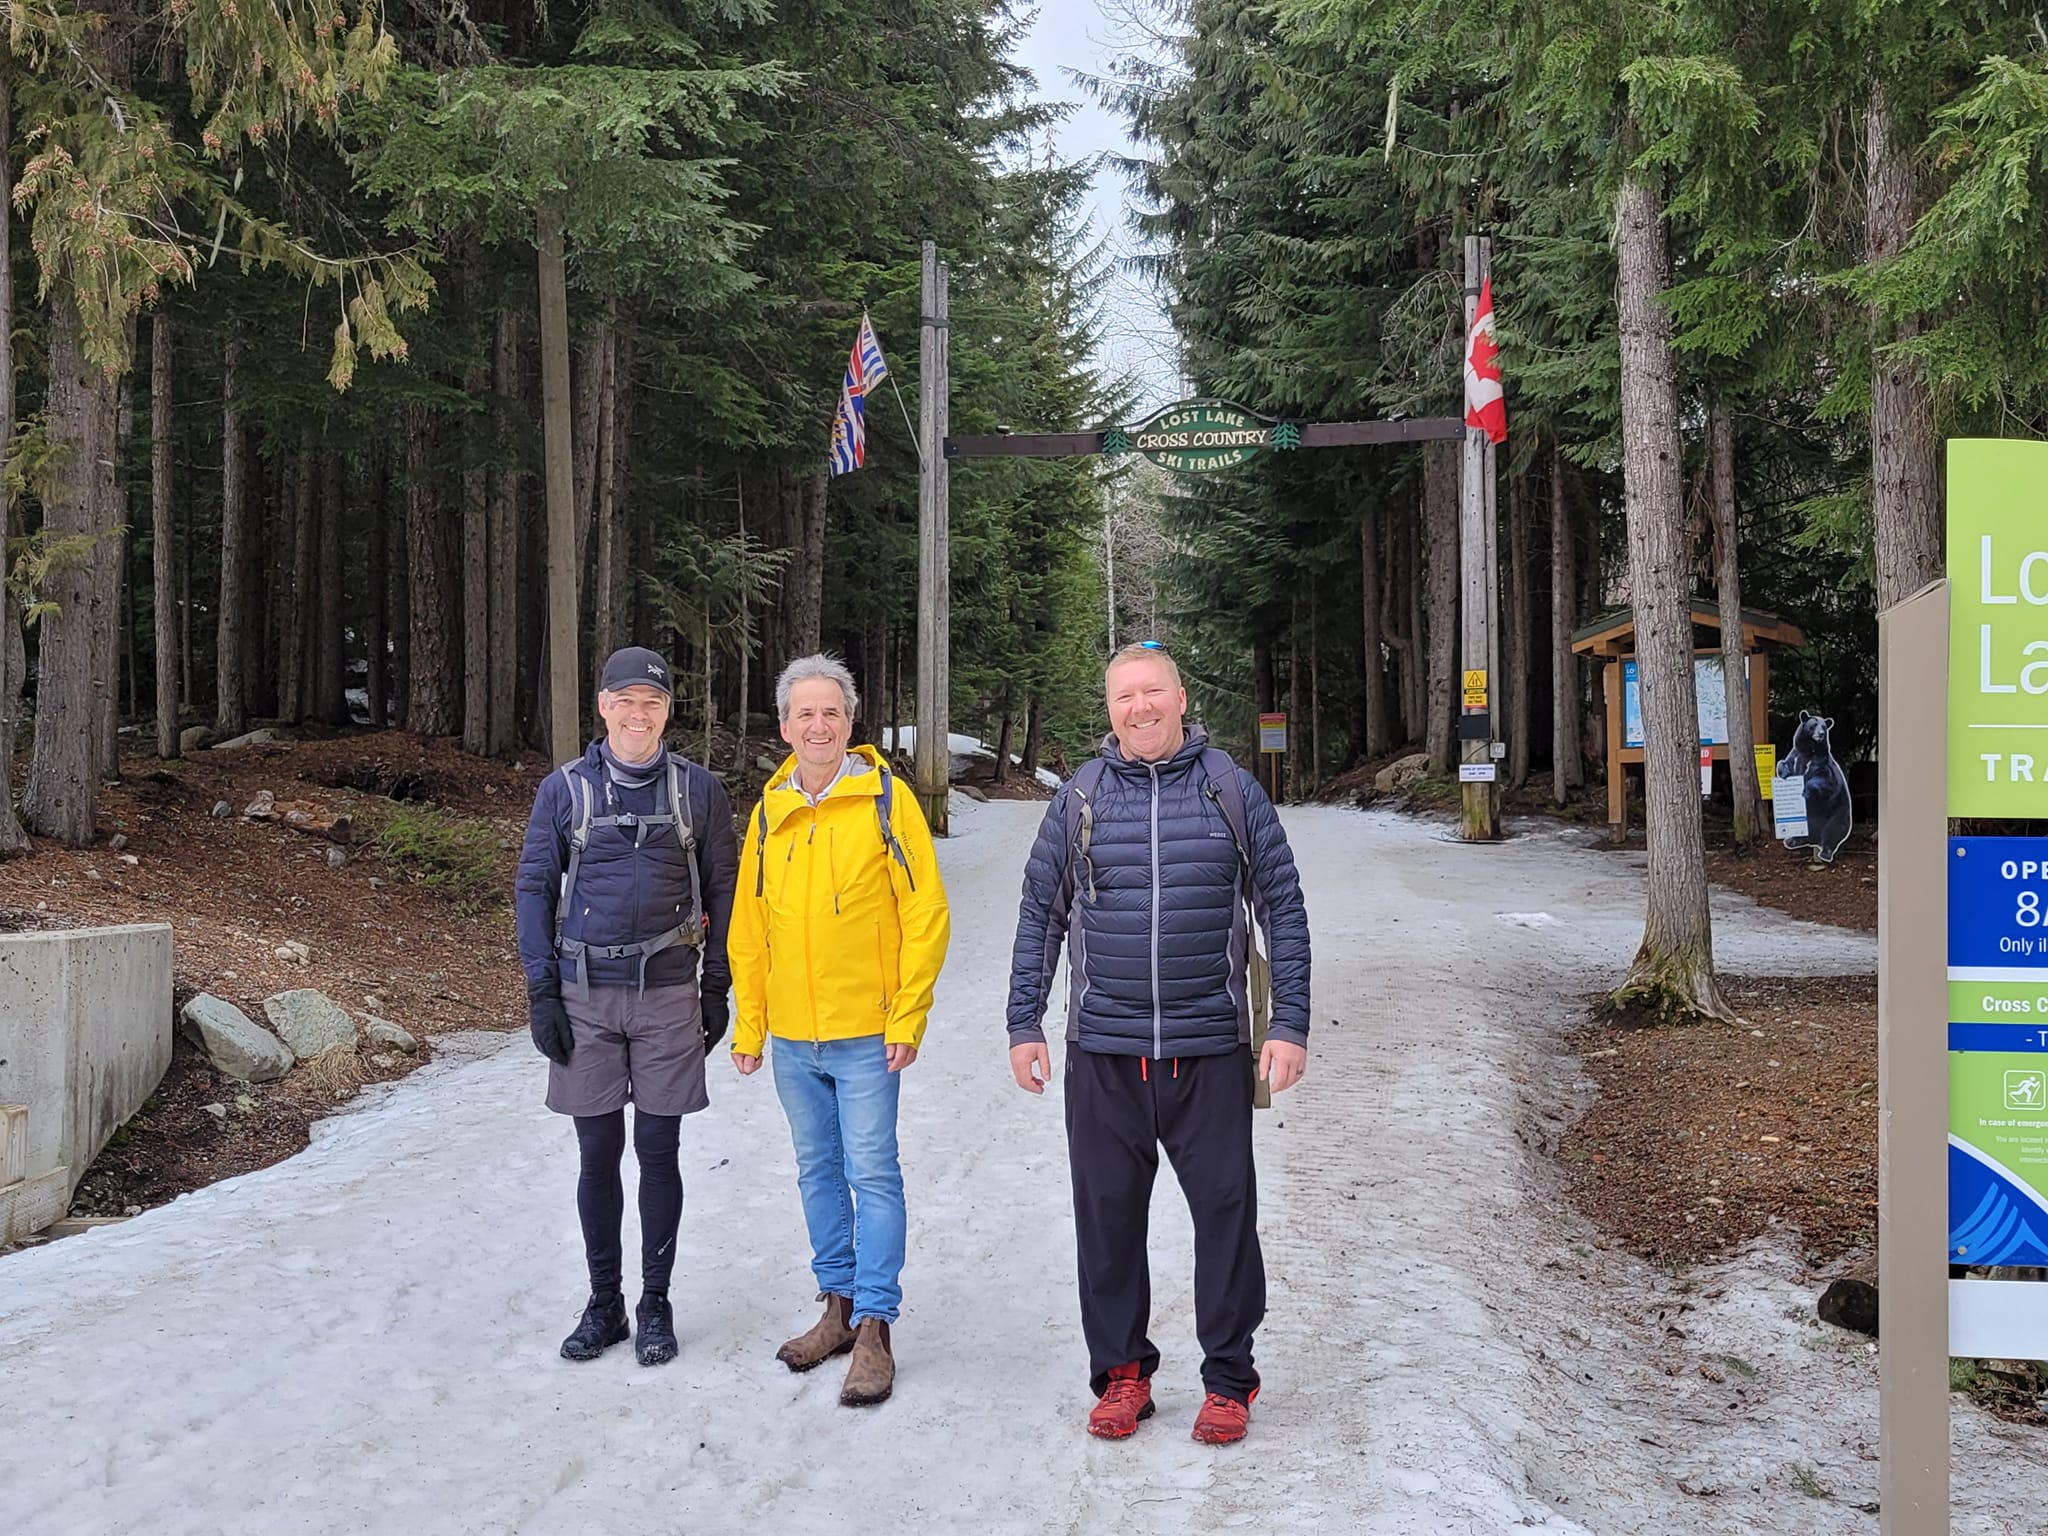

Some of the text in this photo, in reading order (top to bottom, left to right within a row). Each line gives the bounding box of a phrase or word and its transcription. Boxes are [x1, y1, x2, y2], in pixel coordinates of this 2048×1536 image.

[1160, 410, 1245, 429] LOST LAKE
[1136, 430, 1267, 448] CROSS COUNTRY
[1157, 449, 1243, 470] SKI TRAILS
[1979, 753, 2048, 782] TR
[2015, 890, 2048, 928] 8
[2000, 936, 2034, 956] Only
[1982, 995, 2031, 1012] Cross
